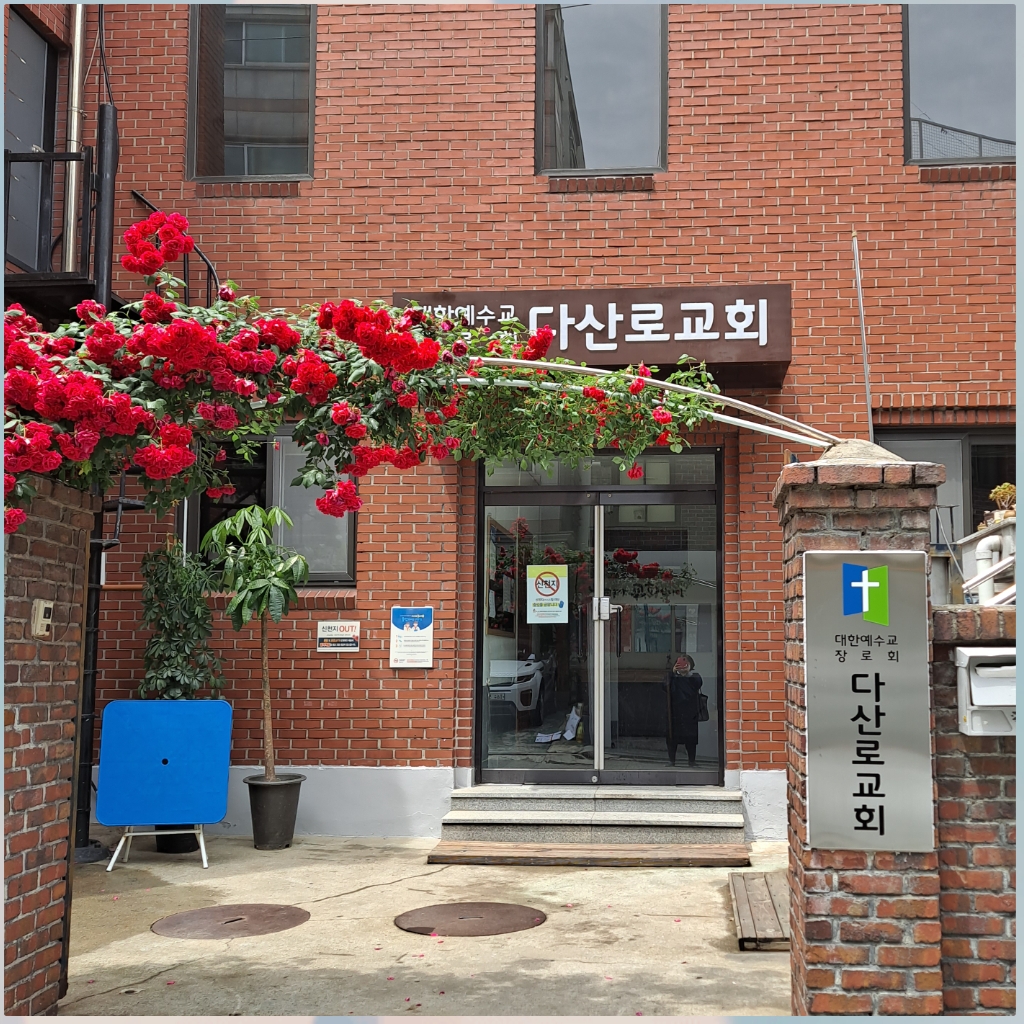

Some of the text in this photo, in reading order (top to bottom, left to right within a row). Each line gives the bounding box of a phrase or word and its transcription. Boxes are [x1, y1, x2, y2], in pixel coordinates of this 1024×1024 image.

[528, 297, 768, 351] 다산로교회
[835, 634, 898, 648] 대한예수교
[850, 672, 886, 836] 다산로교회
